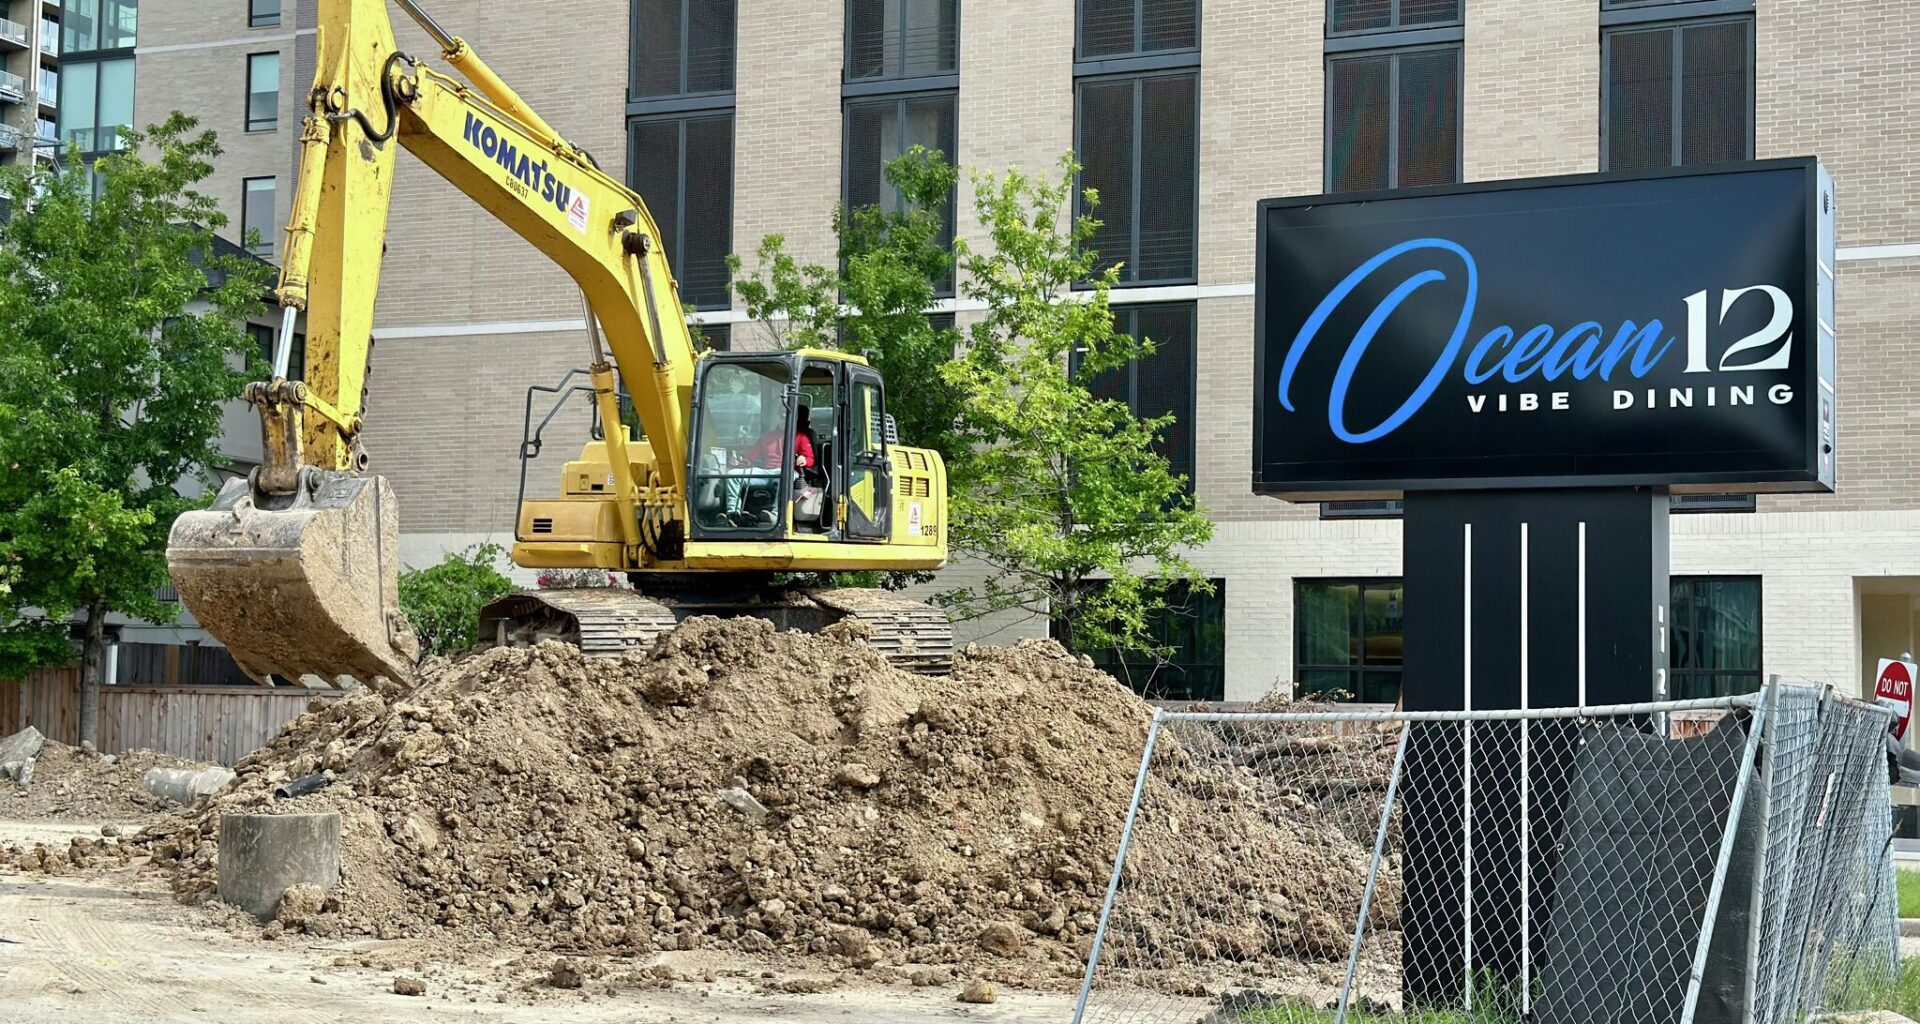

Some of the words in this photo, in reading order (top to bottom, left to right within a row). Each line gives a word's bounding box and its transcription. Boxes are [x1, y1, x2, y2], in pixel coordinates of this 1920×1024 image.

[464, 111, 570, 212] KOMATSU
[1279, 238, 1675, 443] Ocean
[1683, 285, 1793, 373] 12
[1467, 392, 1570, 413] VIBE
[1613, 383, 1794, 410] DINING
[1881, 677, 1892, 693] DO
[1894, 680, 1908, 697] NOT
